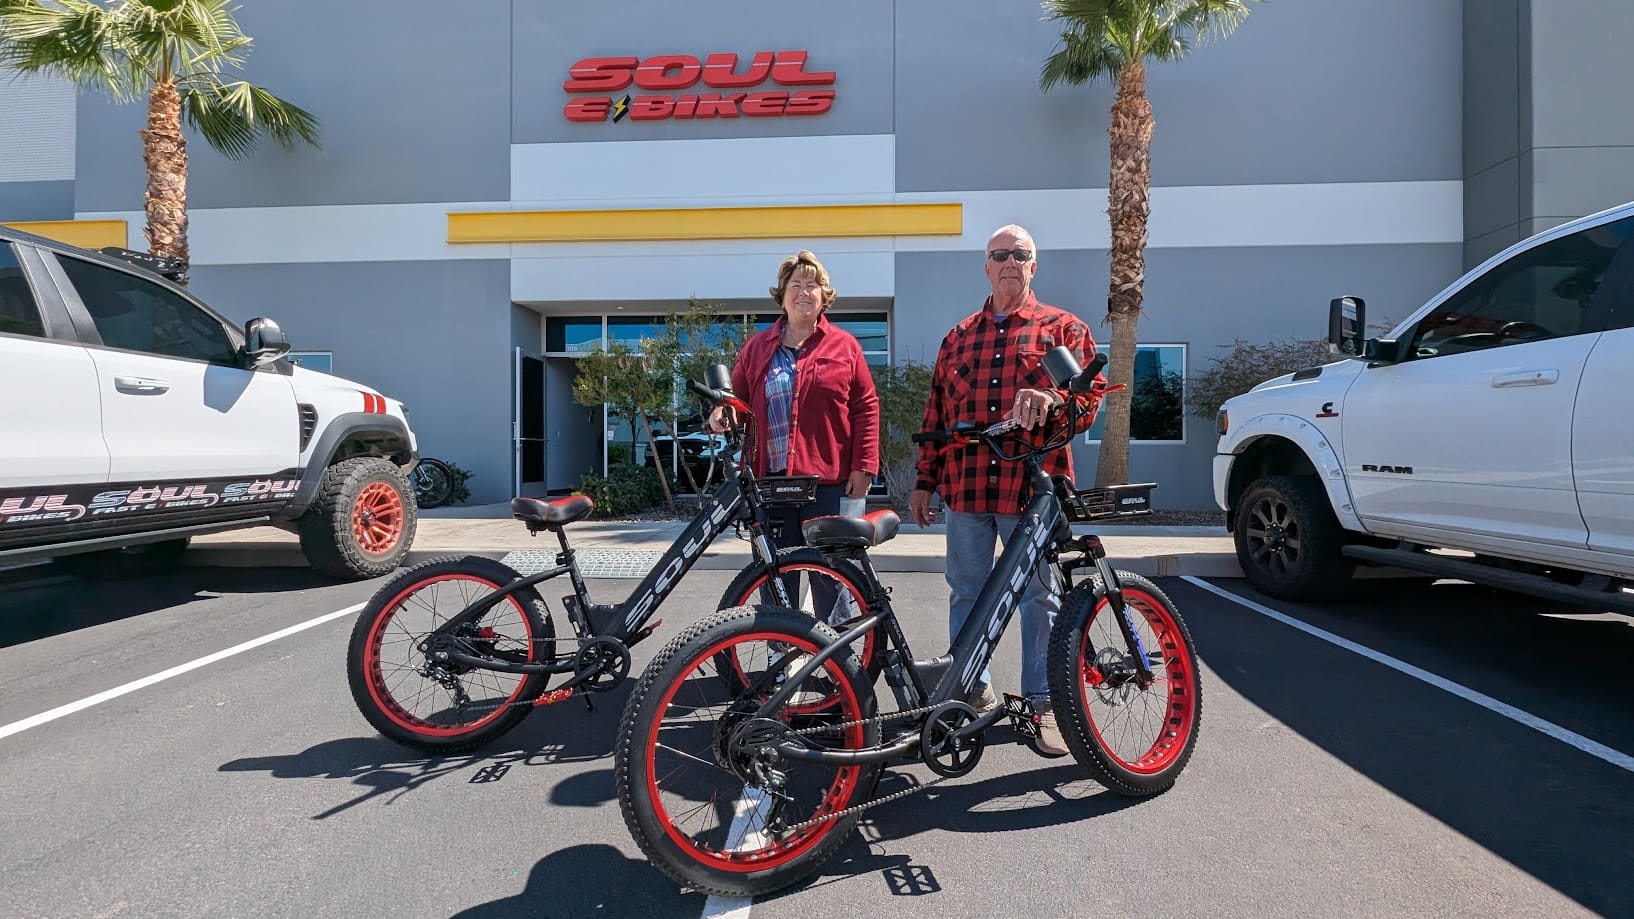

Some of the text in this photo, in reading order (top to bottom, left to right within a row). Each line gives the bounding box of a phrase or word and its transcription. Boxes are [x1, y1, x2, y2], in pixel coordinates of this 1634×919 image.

[563, 49, 836, 93] SOUL
[629, 89, 836, 121] BIKES
[1361, 463, 1414, 475] RAM
[88, 484, 219, 508] SOUL
[92, 504, 141, 515] FAST
[165, 498, 210, 508] BIKES
[6, 511, 72, 523] BIKES
[624, 494, 742, 633] SOUL
[961, 511, 1062, 694] SOUL
